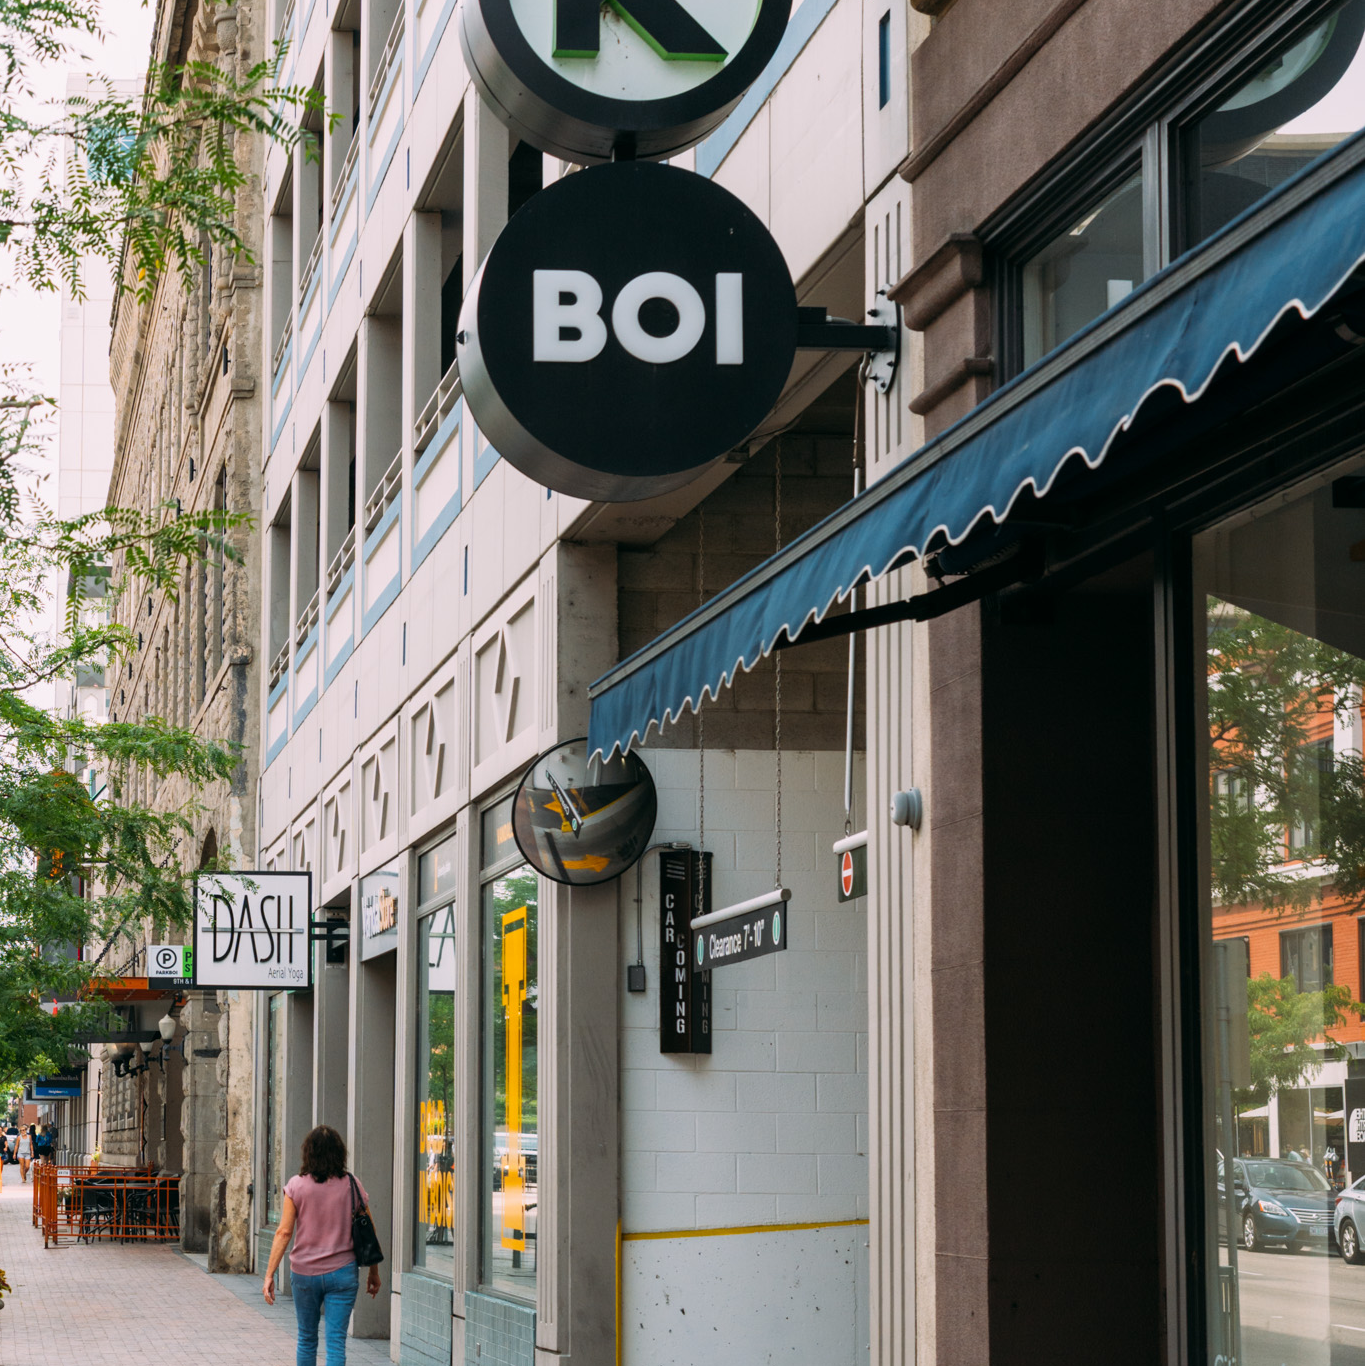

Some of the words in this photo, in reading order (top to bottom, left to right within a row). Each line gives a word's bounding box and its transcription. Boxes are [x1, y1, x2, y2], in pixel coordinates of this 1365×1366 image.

[533, 269, 744, 366] BOI
[212, 893, 294, 965] DASH
[709, 932, 742, 960] Clearance
[268, 966, 287, 979] Aerial
[287, 966, 304, 983] Yoga
[665, 893, 675, 943] CAR
[675, 934, 686, 1034] COMING
[419, 1099, 444, 1155] BOLD
[429, 1170, 455, 1229] BOIS
